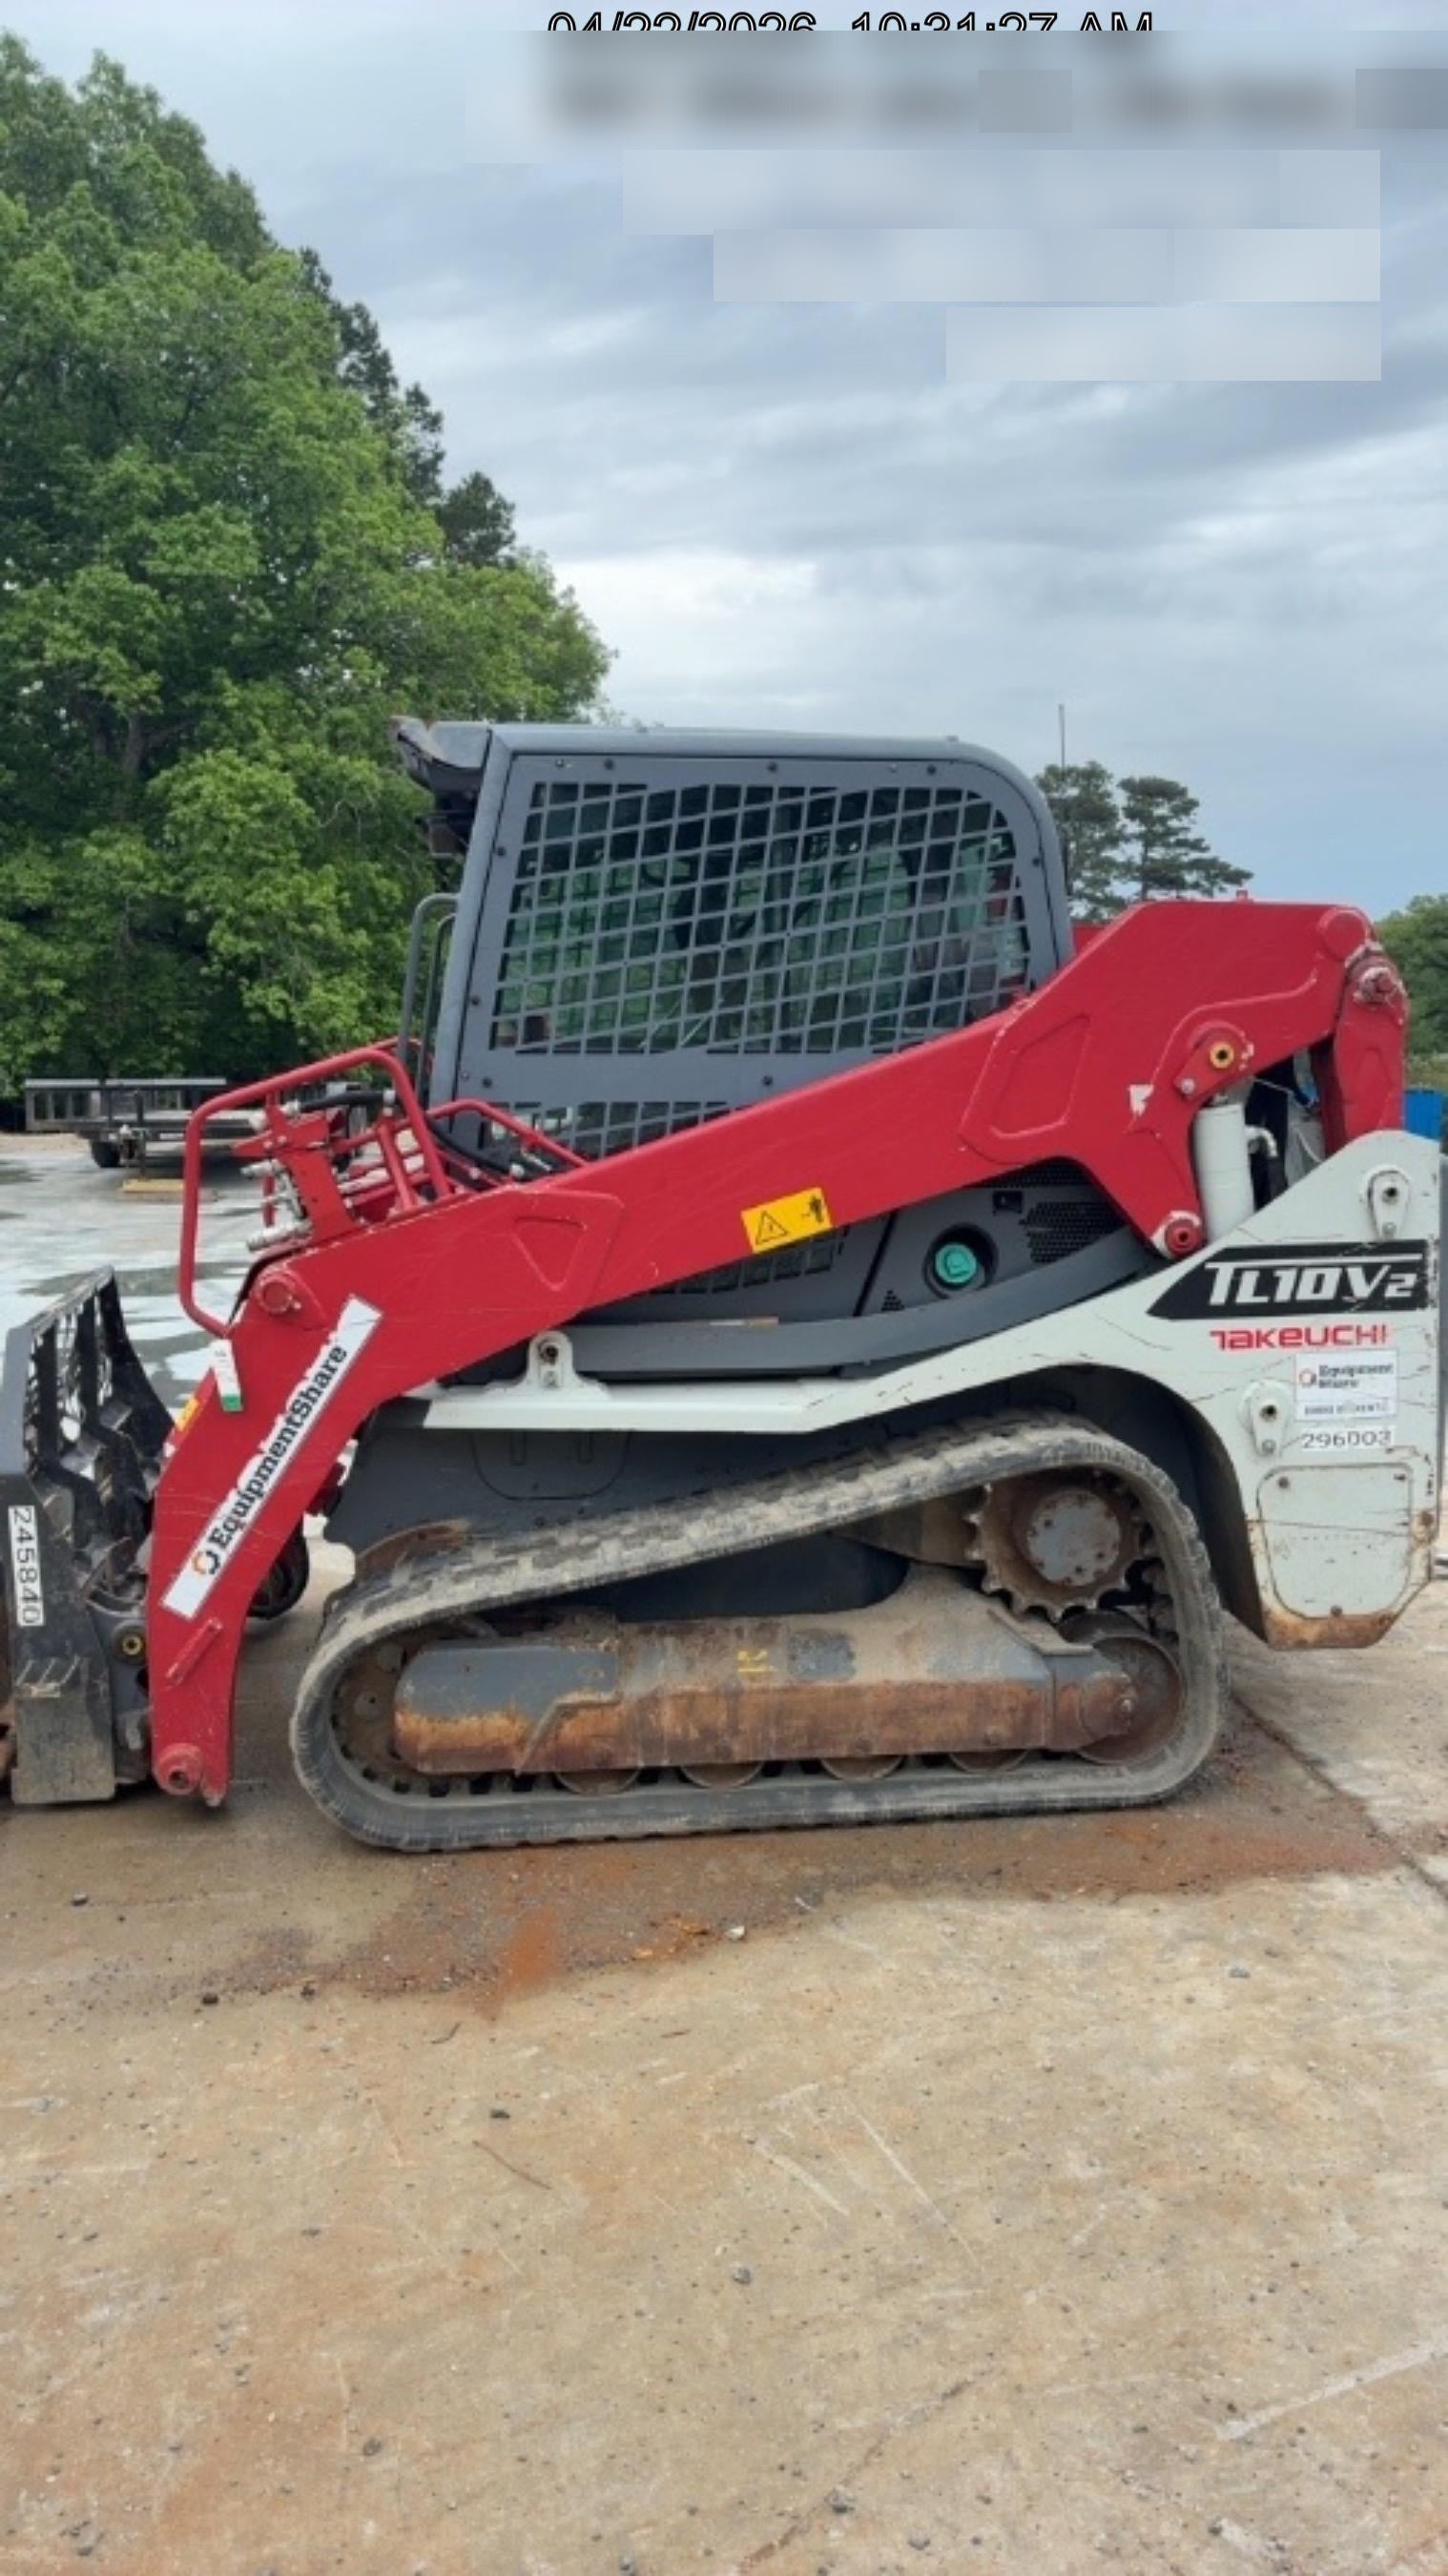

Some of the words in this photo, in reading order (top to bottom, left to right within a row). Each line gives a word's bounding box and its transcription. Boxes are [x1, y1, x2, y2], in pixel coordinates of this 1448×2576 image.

[1204, 1254, 1422, 1306] TL10V2
[209, 1345, 347, 1550] EquipmentShare
[14, 1507, 41, 1624] 245840
